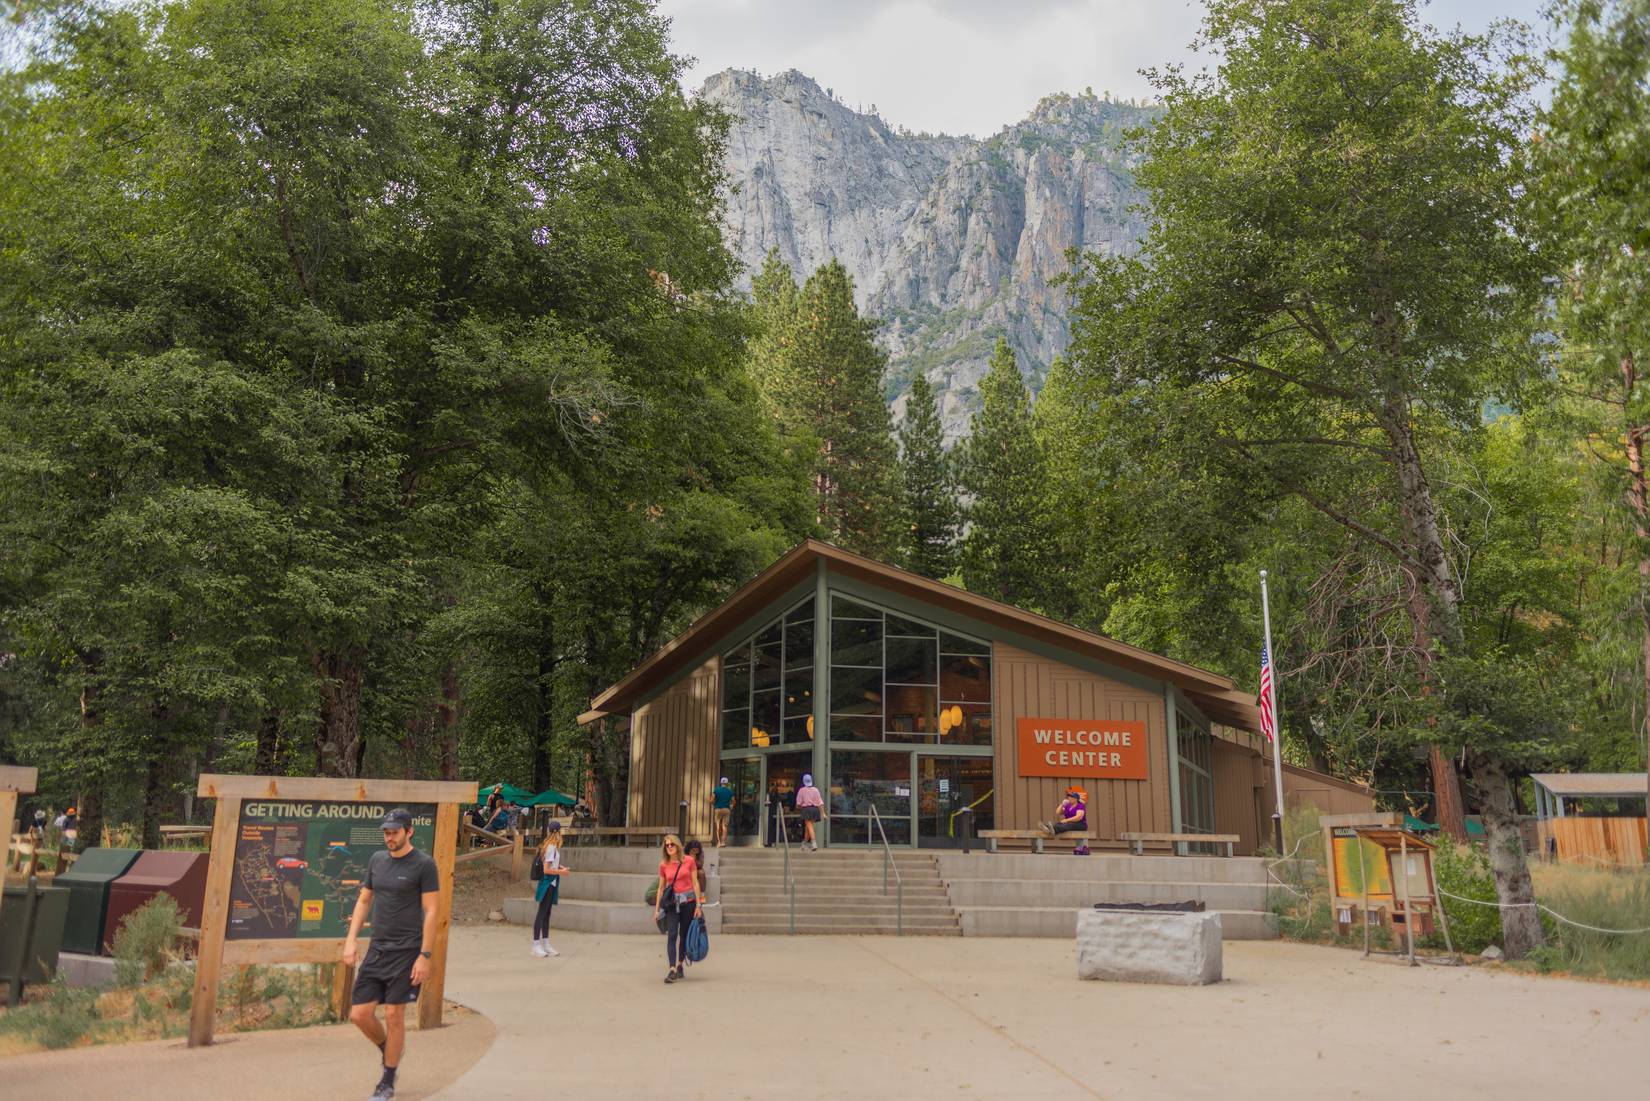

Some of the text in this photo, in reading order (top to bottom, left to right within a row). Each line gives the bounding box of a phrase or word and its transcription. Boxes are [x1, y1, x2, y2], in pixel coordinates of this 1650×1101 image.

[1034, 729, 1132, 746] WELCOME
[1045, 751, 1122, 767] CENTER
[245, 803, 384, 819] GETTING AROUND
